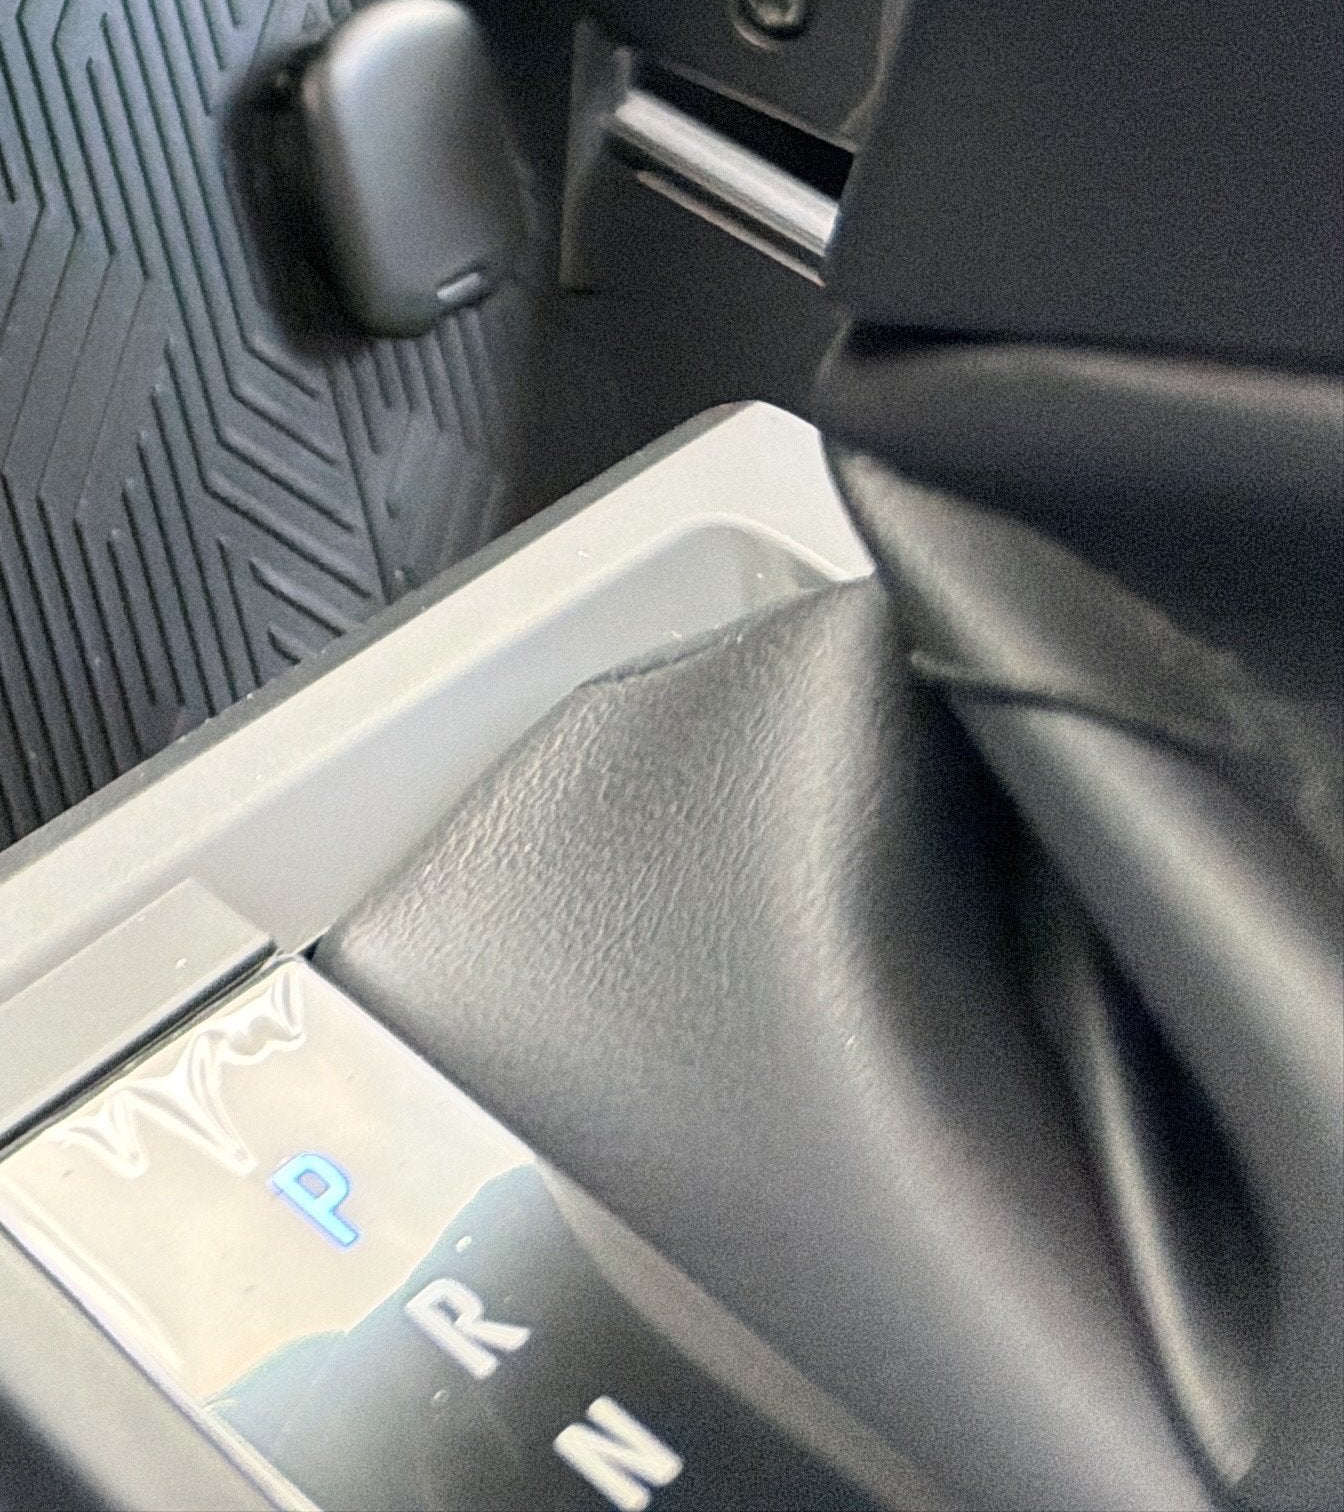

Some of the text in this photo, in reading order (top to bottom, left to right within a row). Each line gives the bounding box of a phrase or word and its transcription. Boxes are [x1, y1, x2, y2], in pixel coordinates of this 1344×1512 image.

[269, 1150, 361, 1248] P
[405, 1279, 532, 1379] R
[554, 1395, 683, 1512] N
